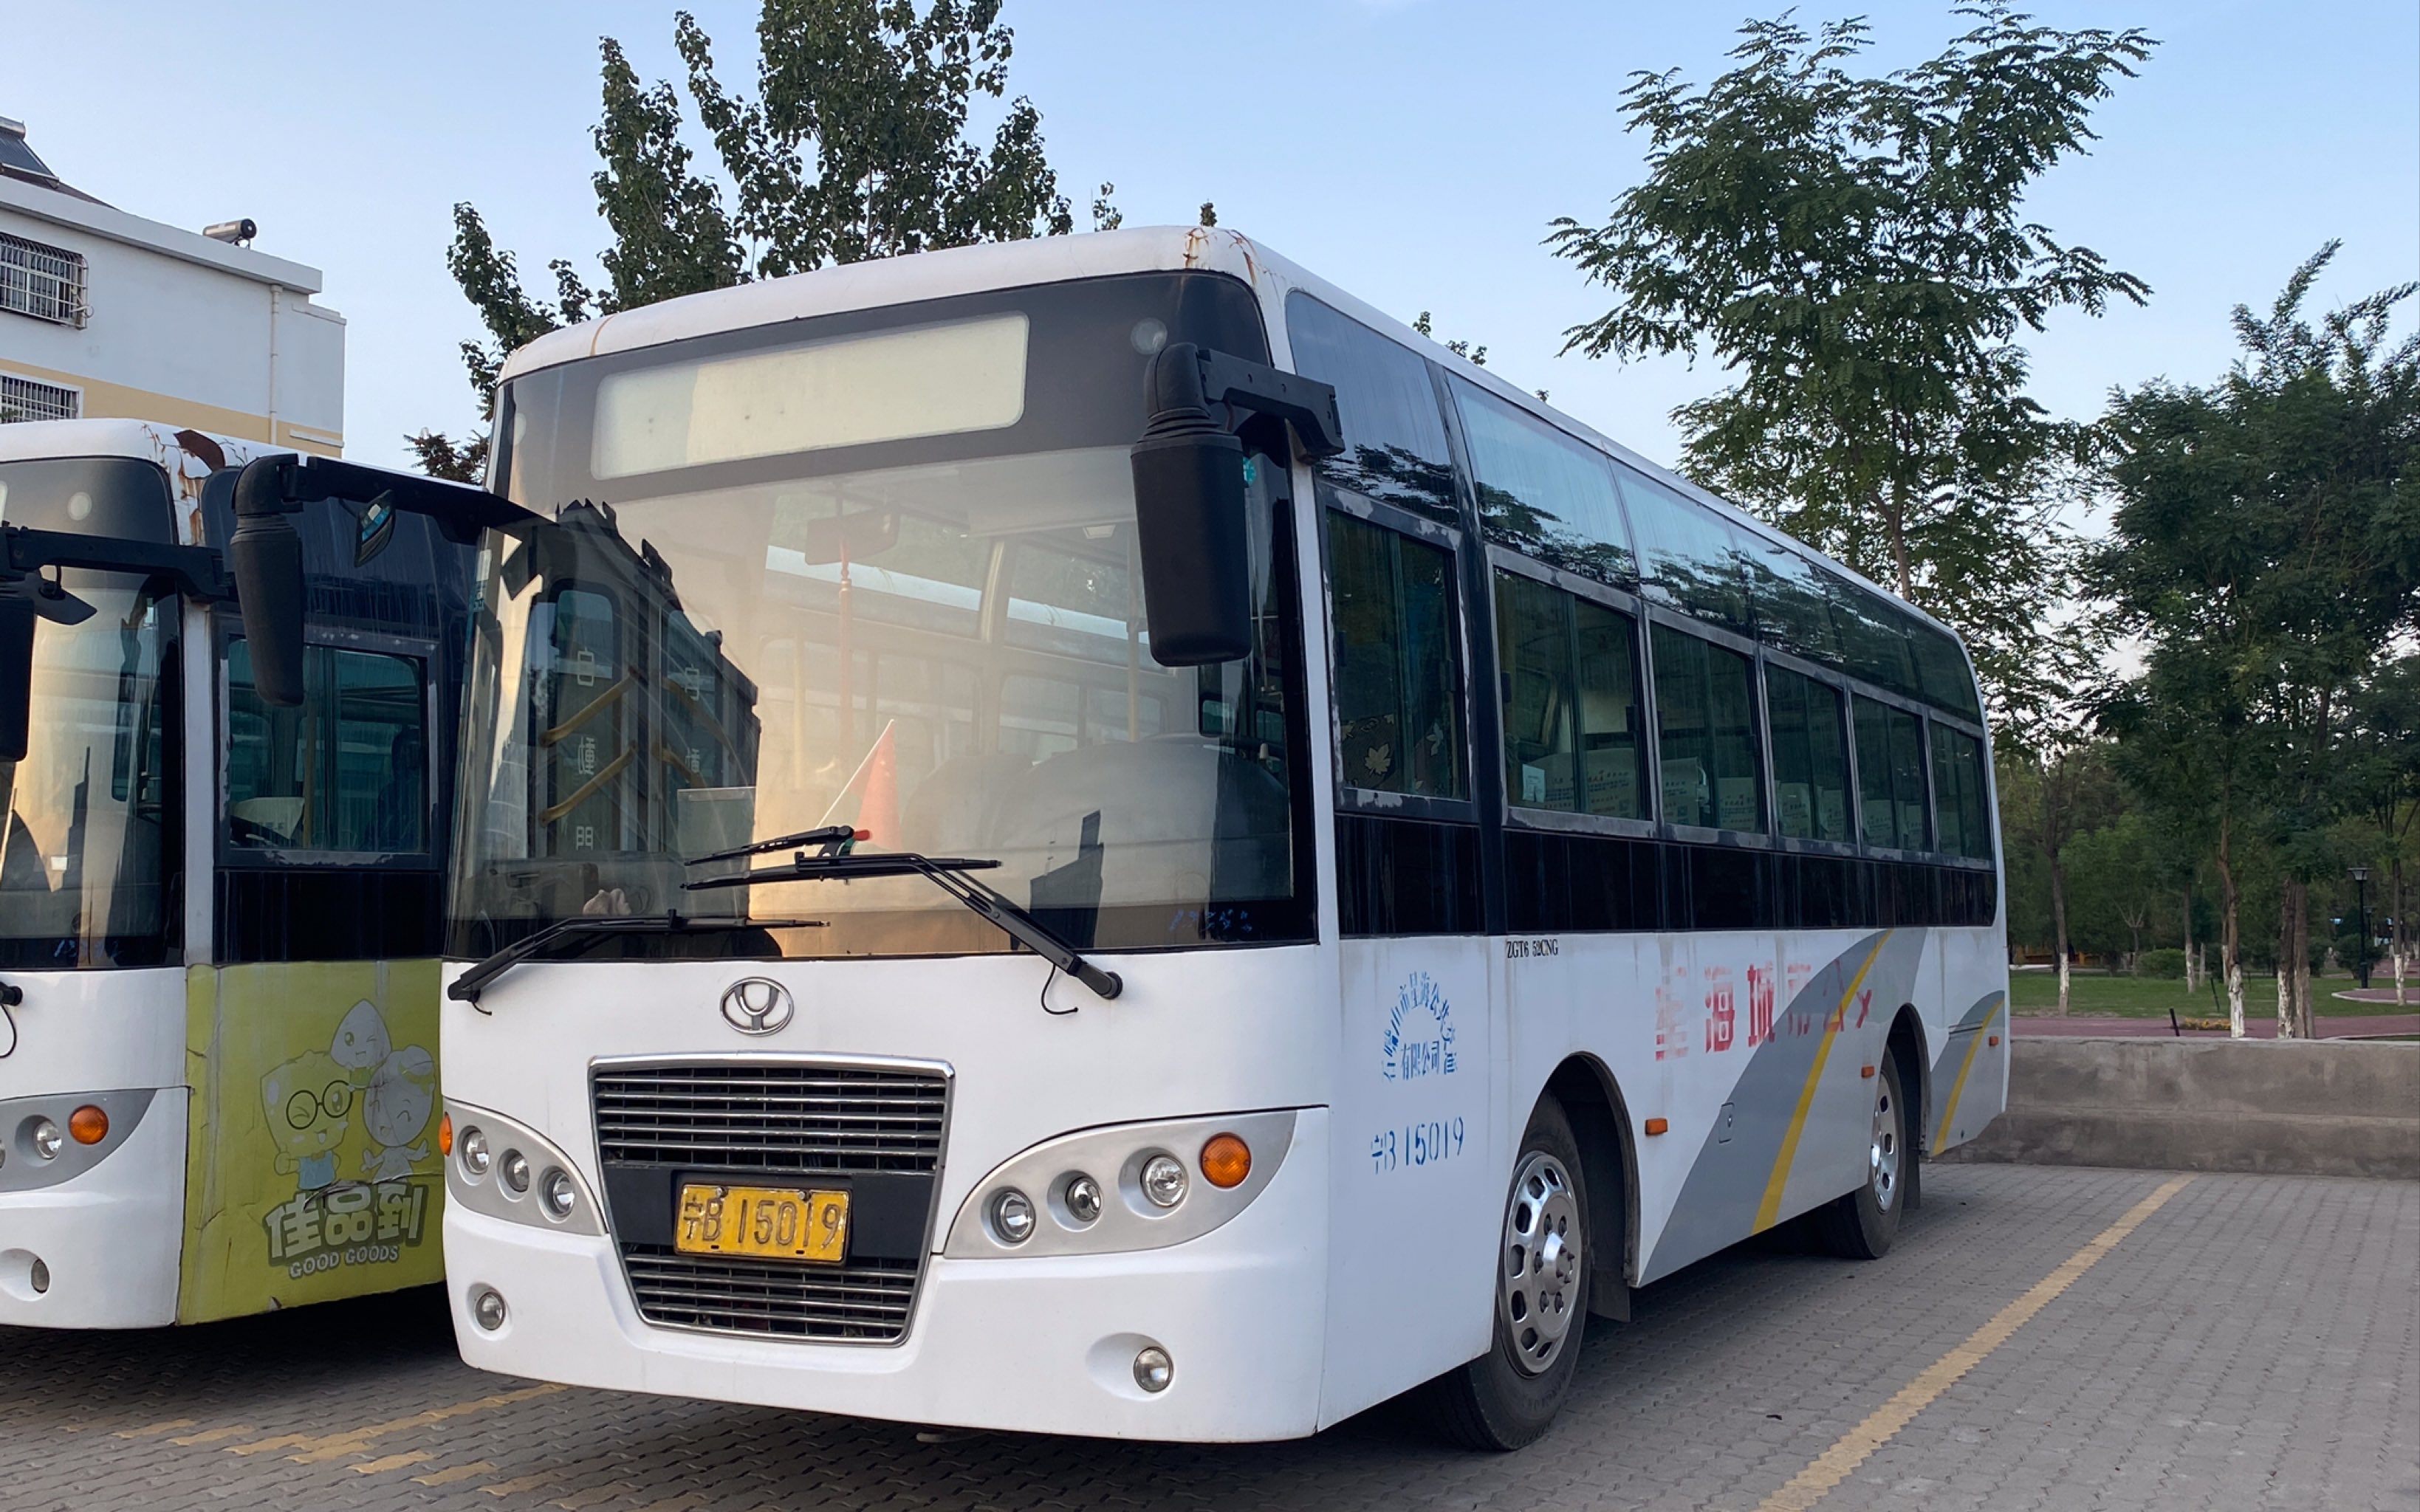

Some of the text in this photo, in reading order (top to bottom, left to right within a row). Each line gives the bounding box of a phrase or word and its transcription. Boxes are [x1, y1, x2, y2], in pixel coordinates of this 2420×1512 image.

[1401, 1040, 1440, 1080] 有限公司
[266, 1183, 423, 1258] 佳品到
[289, 1245, 399, 1279] GOOD GOODS
